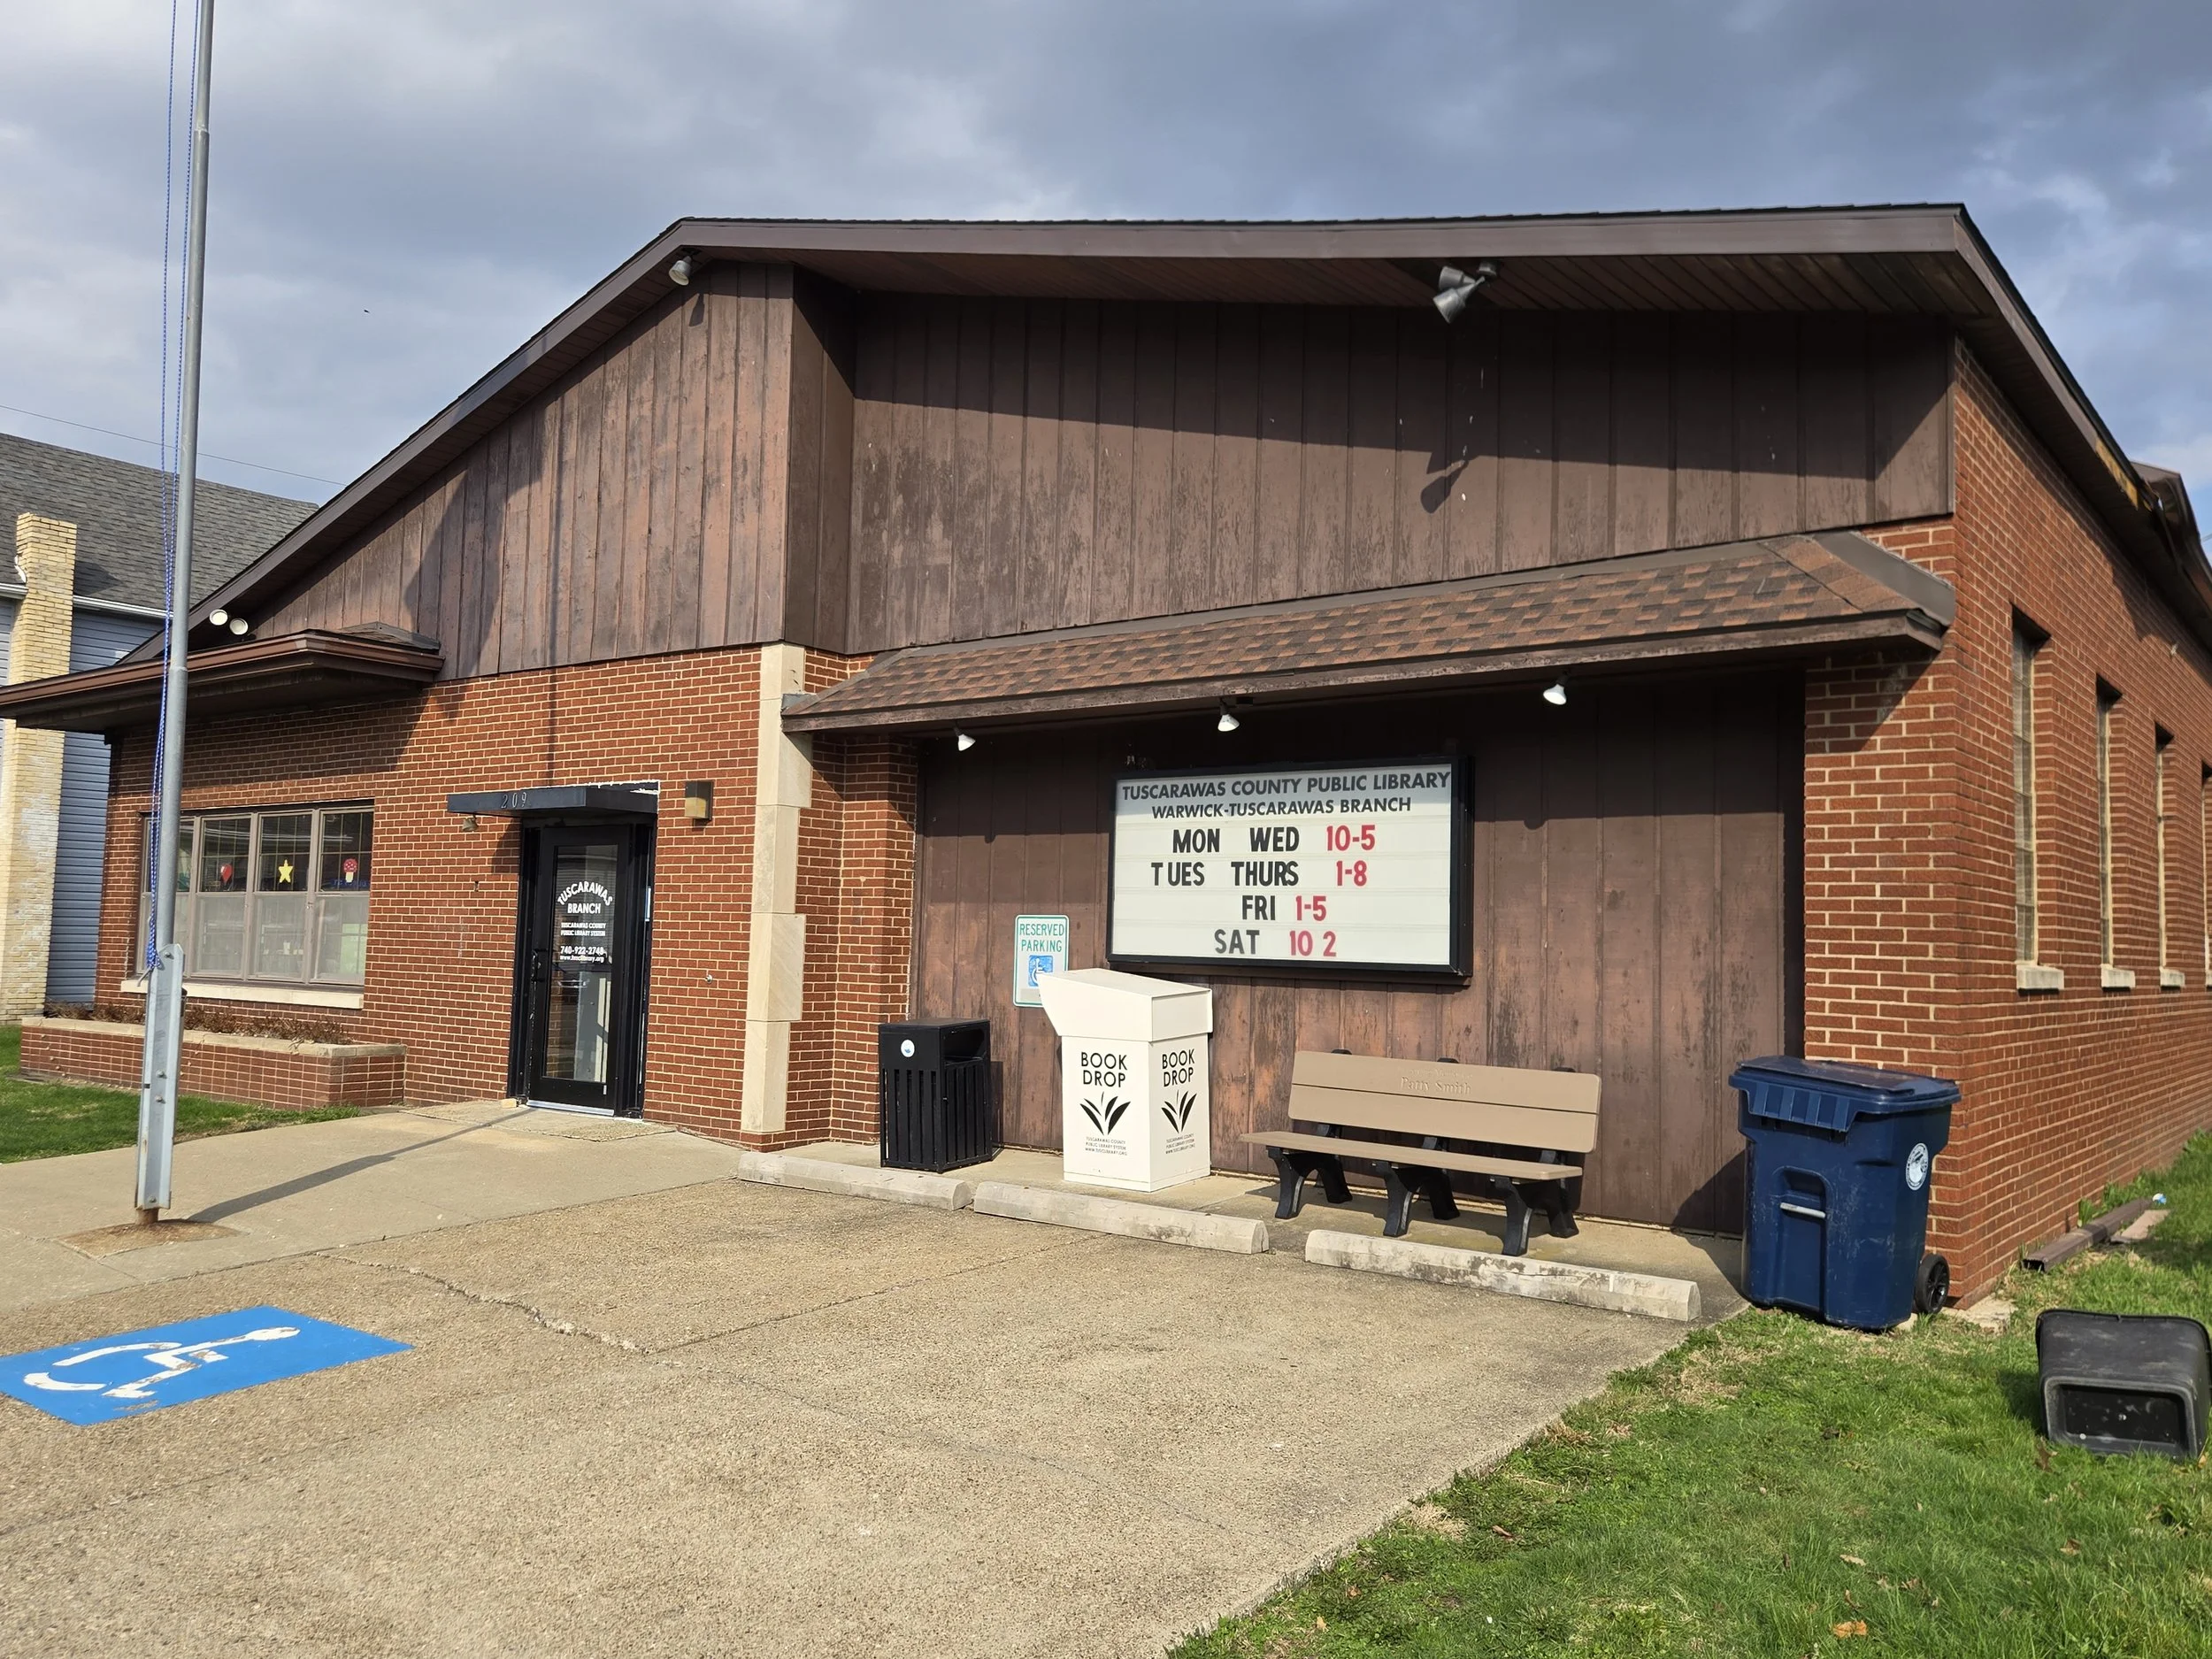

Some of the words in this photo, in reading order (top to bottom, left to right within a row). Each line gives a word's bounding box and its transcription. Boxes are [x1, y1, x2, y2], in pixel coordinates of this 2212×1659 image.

[1122, 781, 1226, 801] TUSCARAWAS
[1231, 778, 1302, 796] COUNTY
[1307, 774, 1368, 794] PUBLIC
[1373, 771, 1451, 790] LIBRARY
[501, 791, 528, 809] 209
[1151, 799, 1334, 819] WARWICK-TUSCARAWAS
[1340, 796, 1411, 814] BRANCH
[1172, 827, 1220, 854] MON
[1249, 826, 1300, 852] WED
[1326, 824, 1376, 851] 10-5
[1150, 861, 1205, 887] TUES
[1231, 861, 1299, 887] THURS
[1336, 859, 1368, 887] 1-8
[557, 880, 613, 907] TUSCARAWAS
[567, 902, 602, 914] BRANCH
[1241, 895, 1276, 921] FRI
[1295, 895, 1327, 921] 1-5
[1019, 923, 1065, 936] RESERVED
[1021, 939, 1063, 952] PARKING
[1214, 929, 1260, 956] SAT
[1080, 1051, 1128, 1071] BOOK
[1162, 1048, 1195, 1070] BOOK
[1082, 1069, 1126, 1087] DROP
[1164, 1066, 1194, 1087] DROP
[1435, 1079, 1472, 1095] Smith
